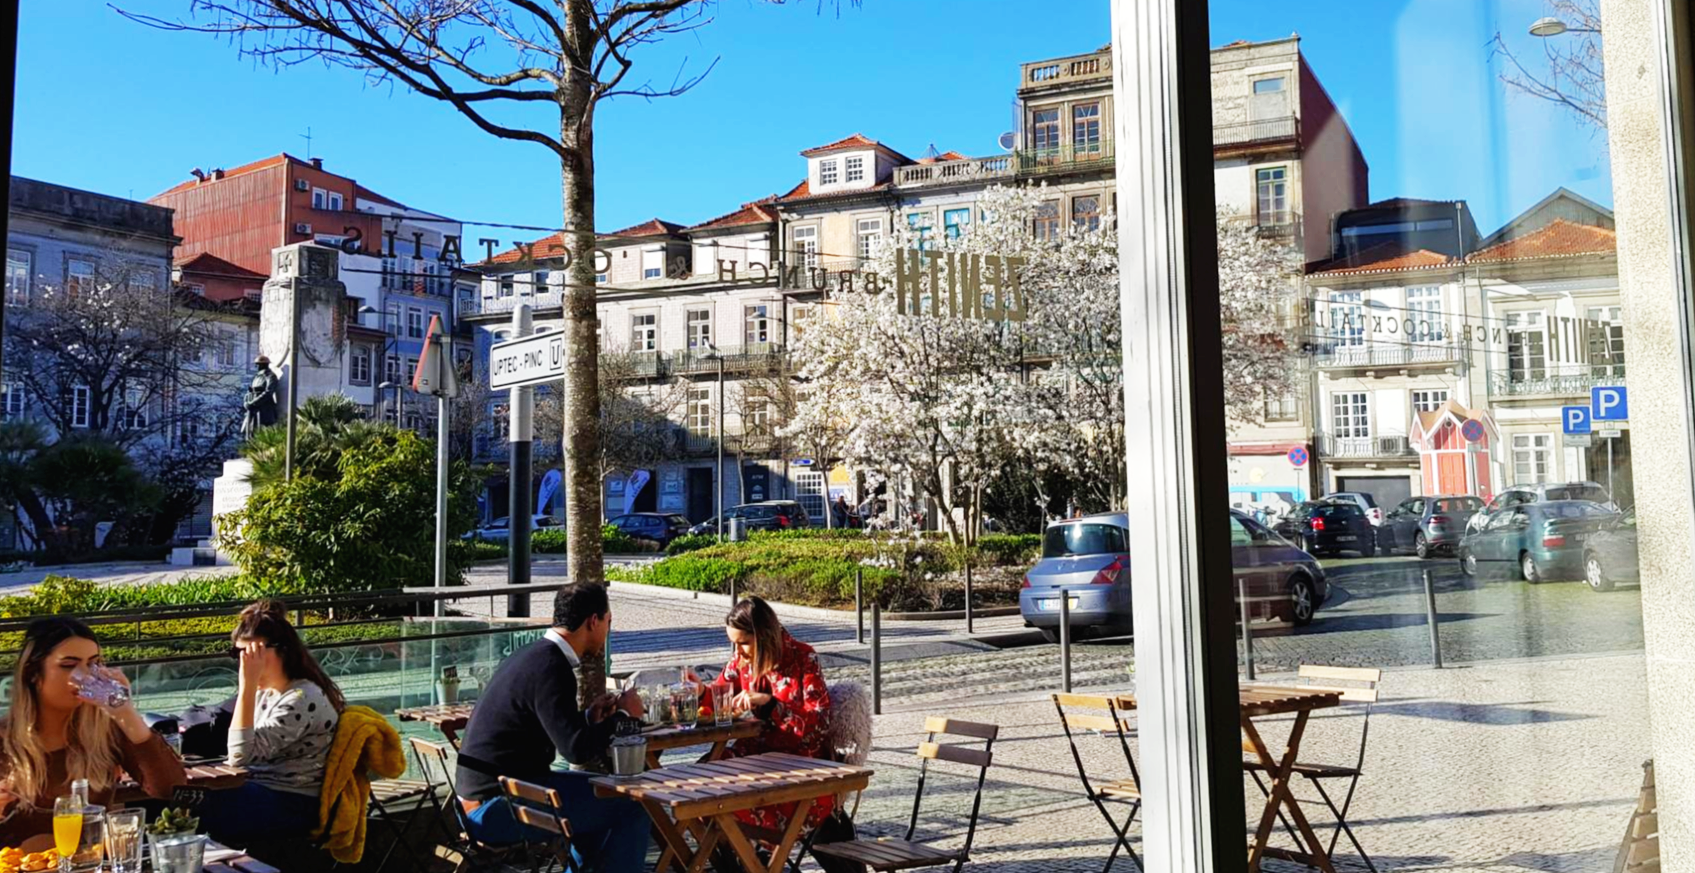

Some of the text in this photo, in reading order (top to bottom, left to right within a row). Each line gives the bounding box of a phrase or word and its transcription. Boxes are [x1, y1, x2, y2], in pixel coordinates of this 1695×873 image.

[493, 355, 517, 376] UPTEC
[524, 349, 542, 369] PINC
[551, 344, 560, 365] U
[1599, 389, 1620, 417] P
[1568, 409, 1584, 431] P
